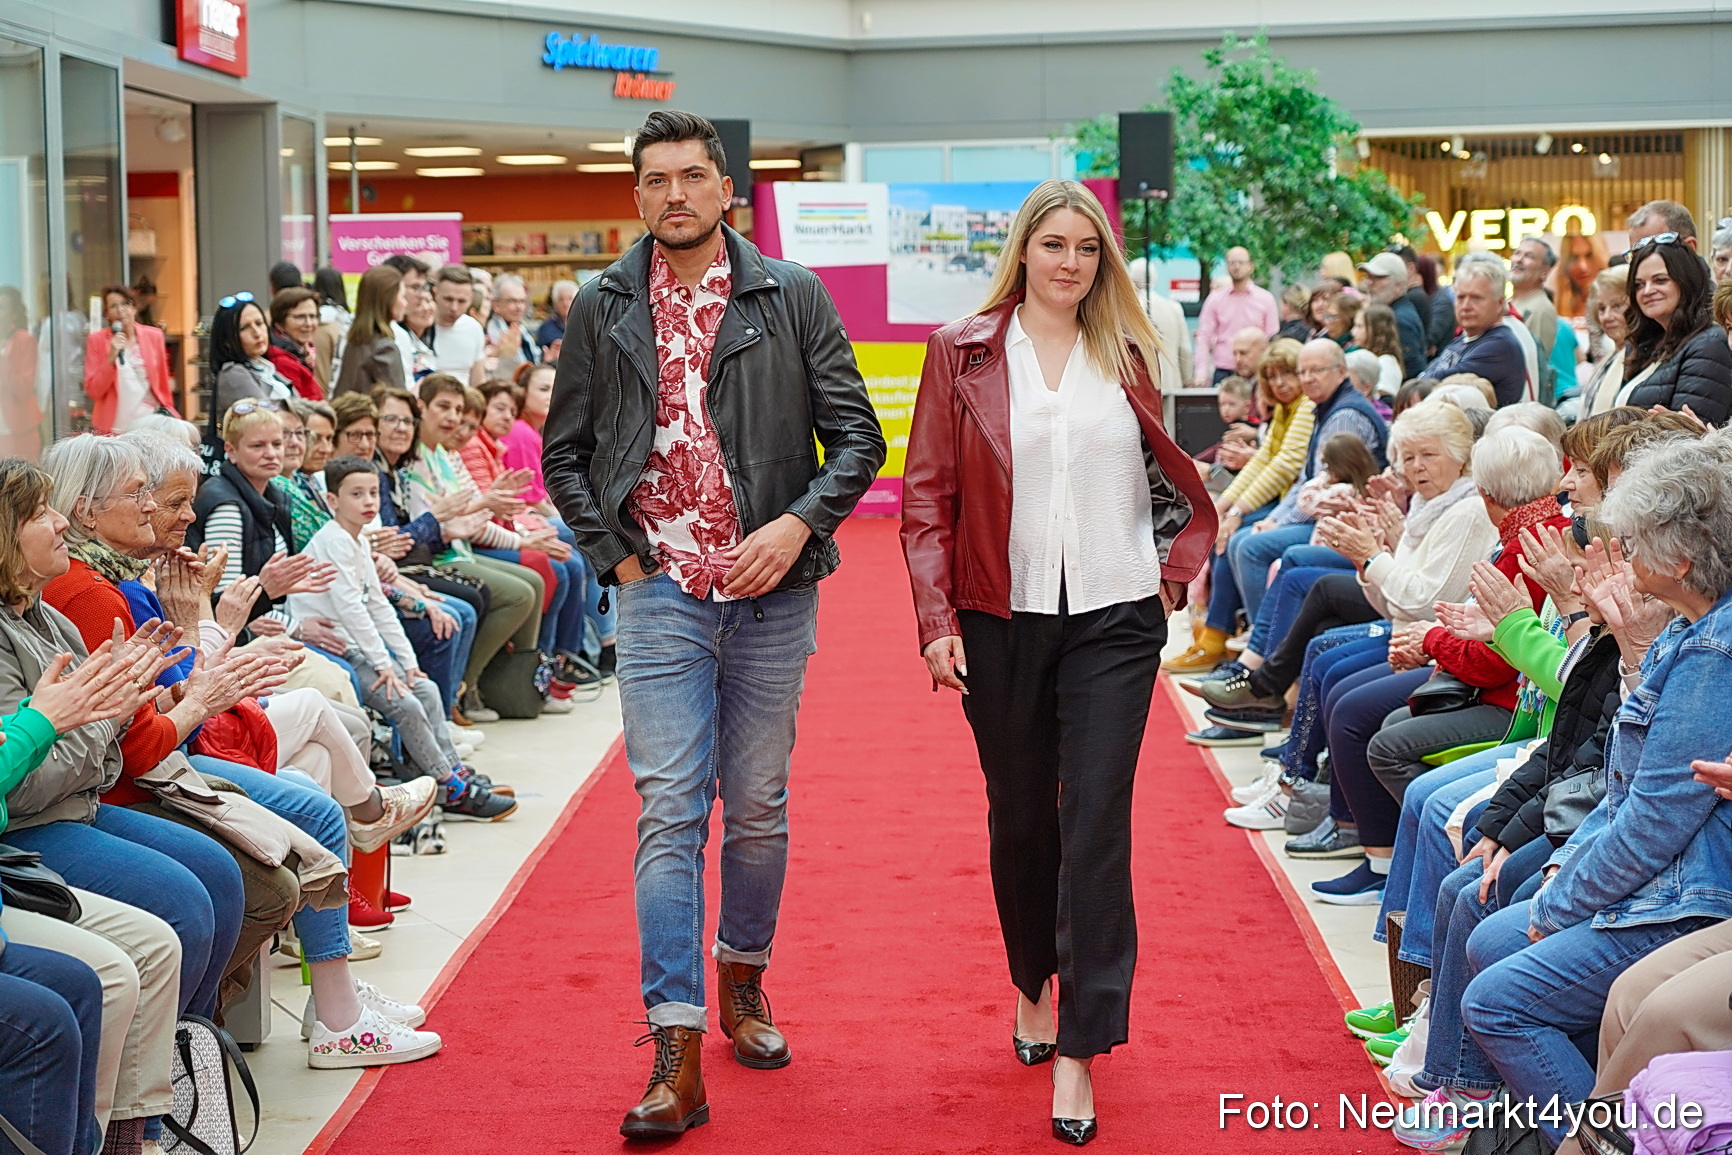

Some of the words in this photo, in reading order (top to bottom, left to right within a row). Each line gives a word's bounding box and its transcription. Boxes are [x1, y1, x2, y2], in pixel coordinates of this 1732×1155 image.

[543, 31, 659, 71] Spielwaren
[337, 235, 424, 251] Verschenken
[424, 234, 449, 250] Sie
[1425, 203, 1597, 252] VERO
